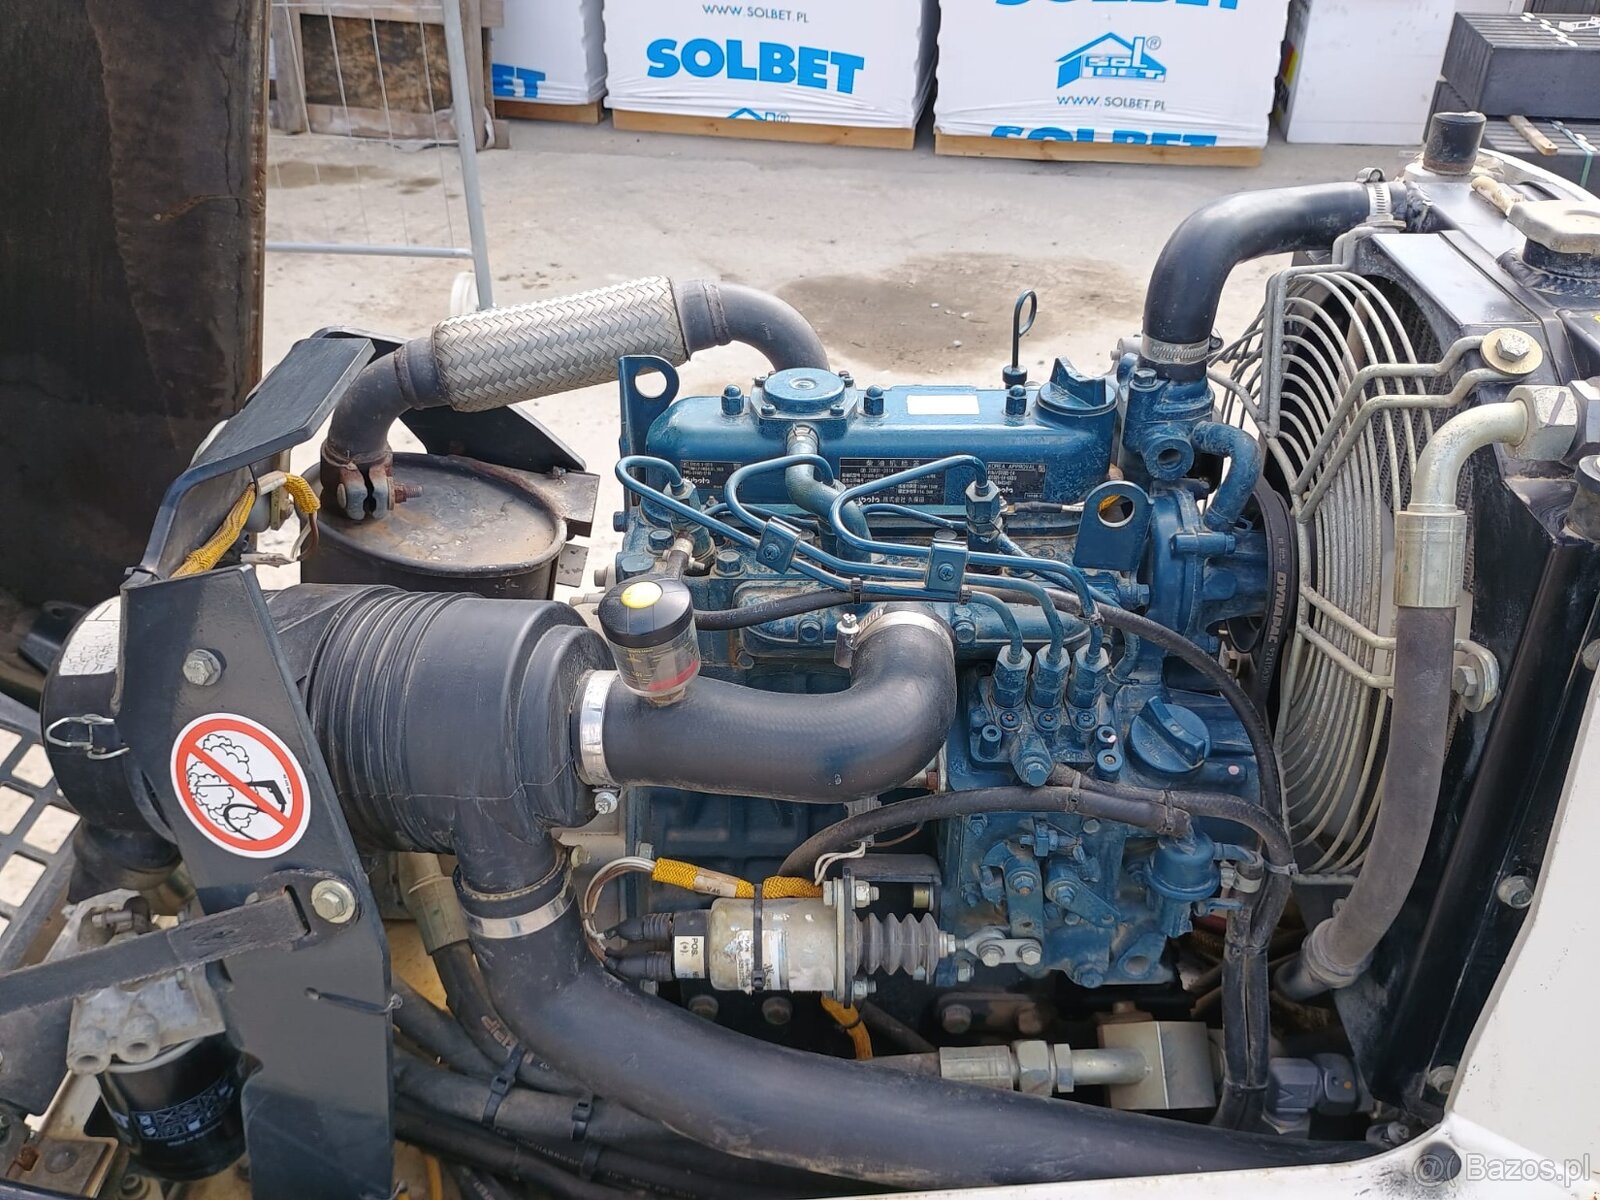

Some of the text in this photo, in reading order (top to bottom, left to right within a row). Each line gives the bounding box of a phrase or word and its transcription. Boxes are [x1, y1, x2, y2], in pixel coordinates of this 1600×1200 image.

[702, 4, 810, 24] WWW.SOLBET.PL
[646, 38, 865, 95] SOLBET
[1056, 95, 1167, 112] WWW.SOLBET.PL
